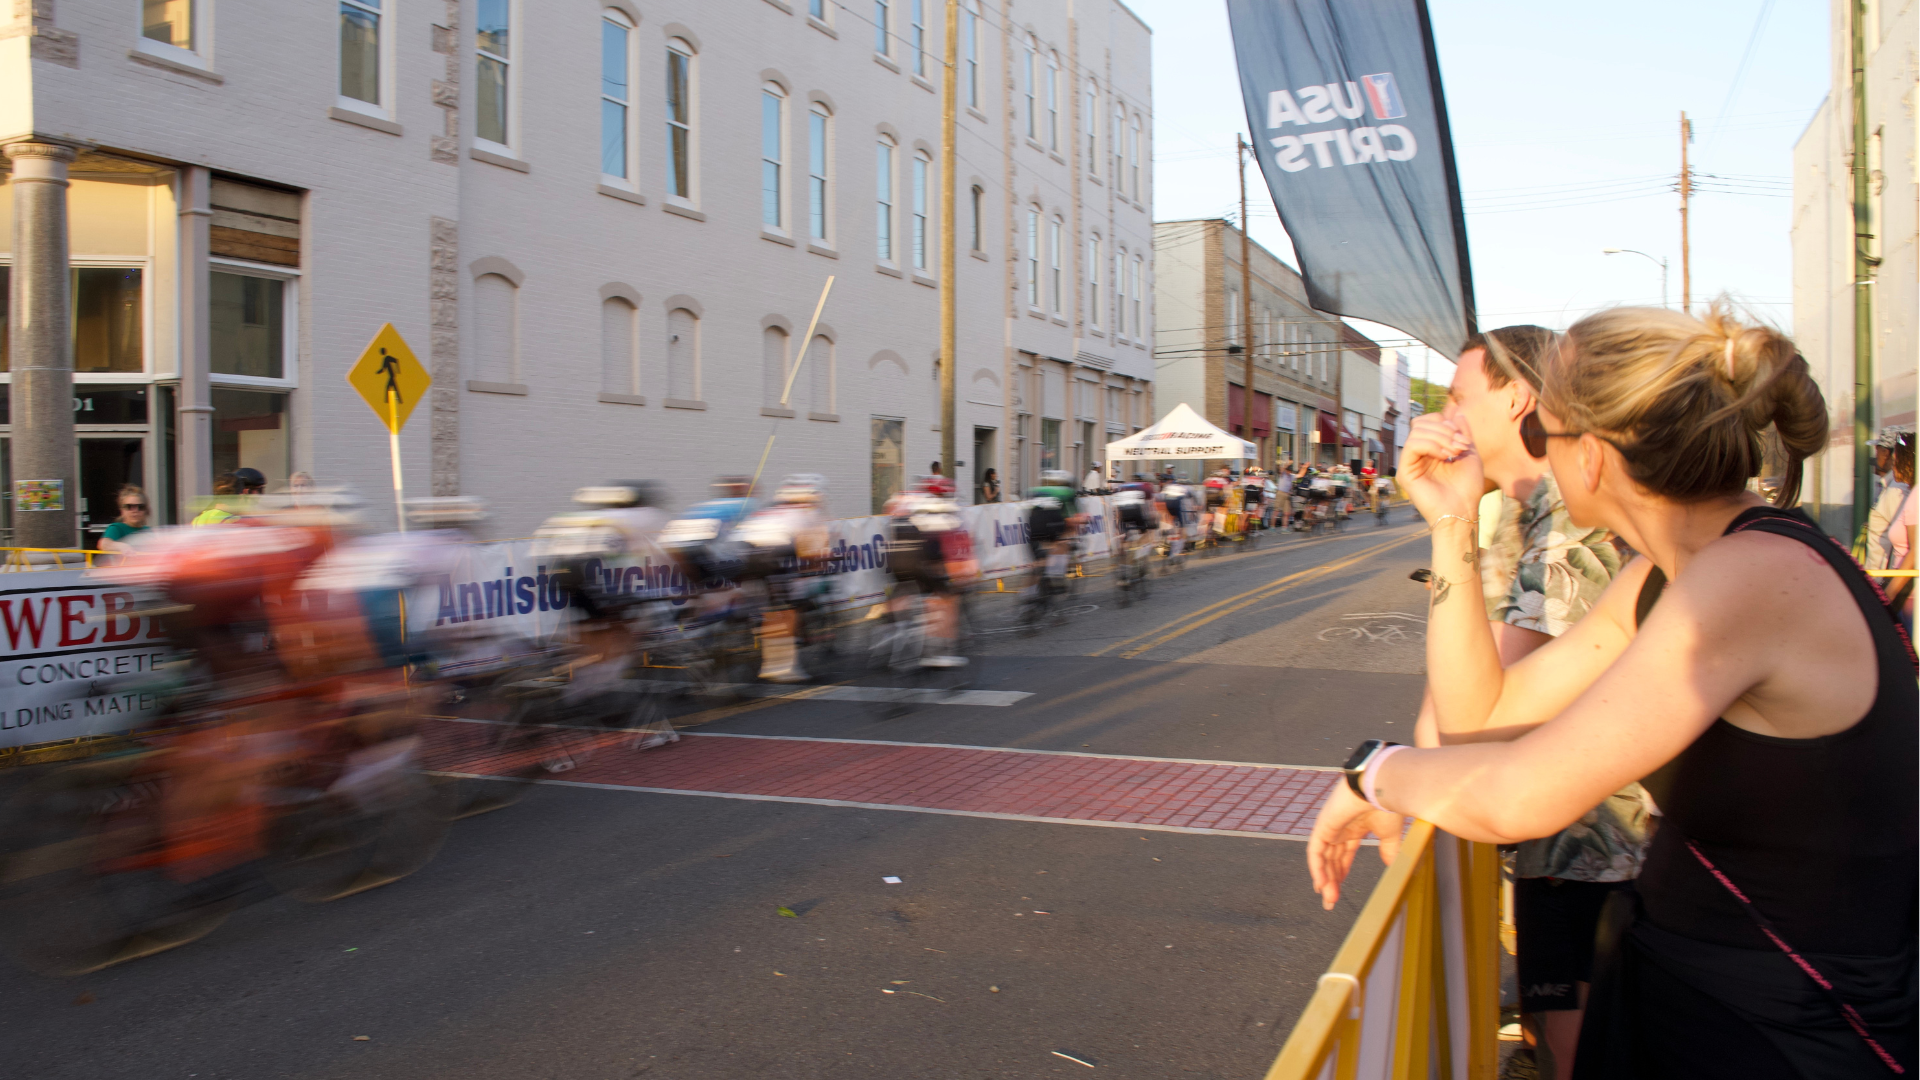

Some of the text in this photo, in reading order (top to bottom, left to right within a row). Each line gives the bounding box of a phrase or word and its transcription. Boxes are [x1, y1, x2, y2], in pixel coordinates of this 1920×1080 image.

[1124, 445, 1224, 456] NEUTRAL SUPPORT
[17, 653, 165, 686] CONCRETE
